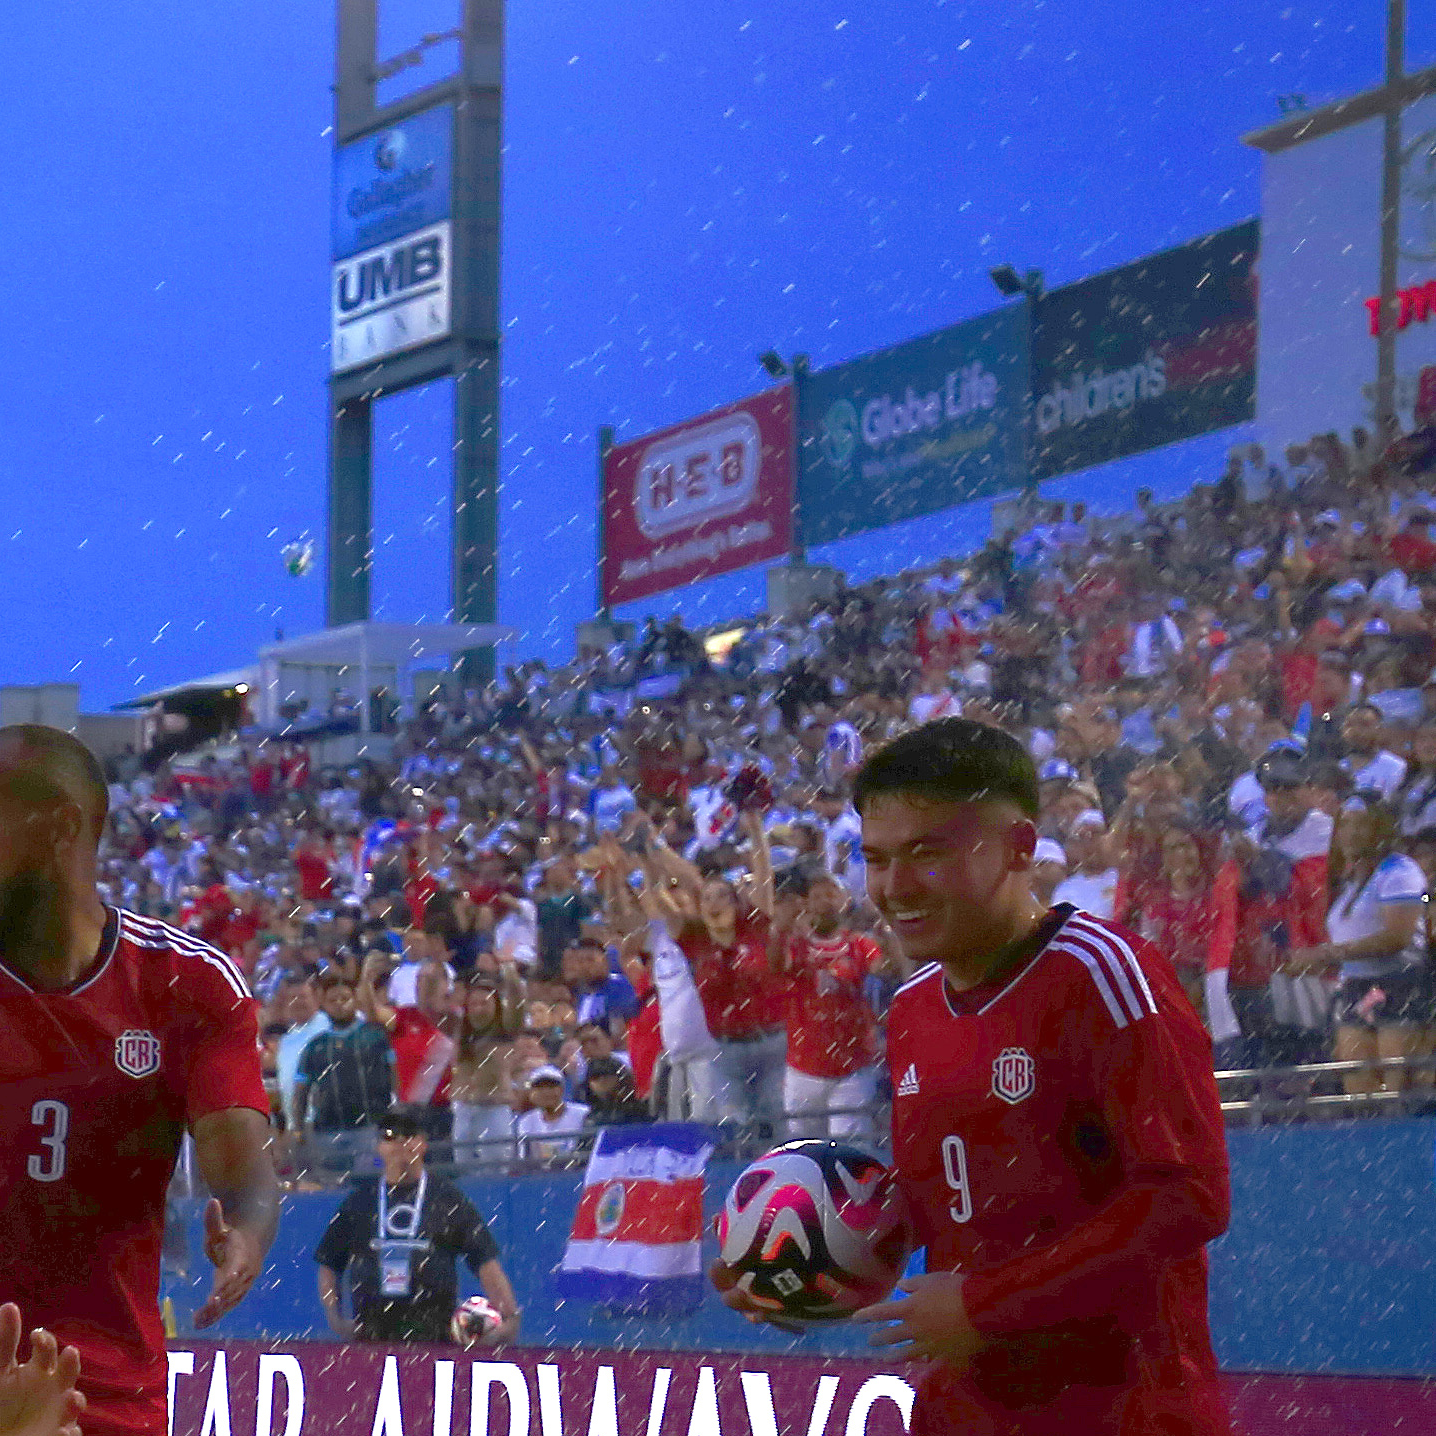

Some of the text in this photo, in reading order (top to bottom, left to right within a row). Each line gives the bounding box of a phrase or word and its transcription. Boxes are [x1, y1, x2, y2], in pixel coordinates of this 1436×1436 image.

[339, 237, 442, 312] UMB
[863, 360, 998, 446] Globe Life
[27, 1099, 70, 1183] 3
[941, 1134, 973, 1223] 9
